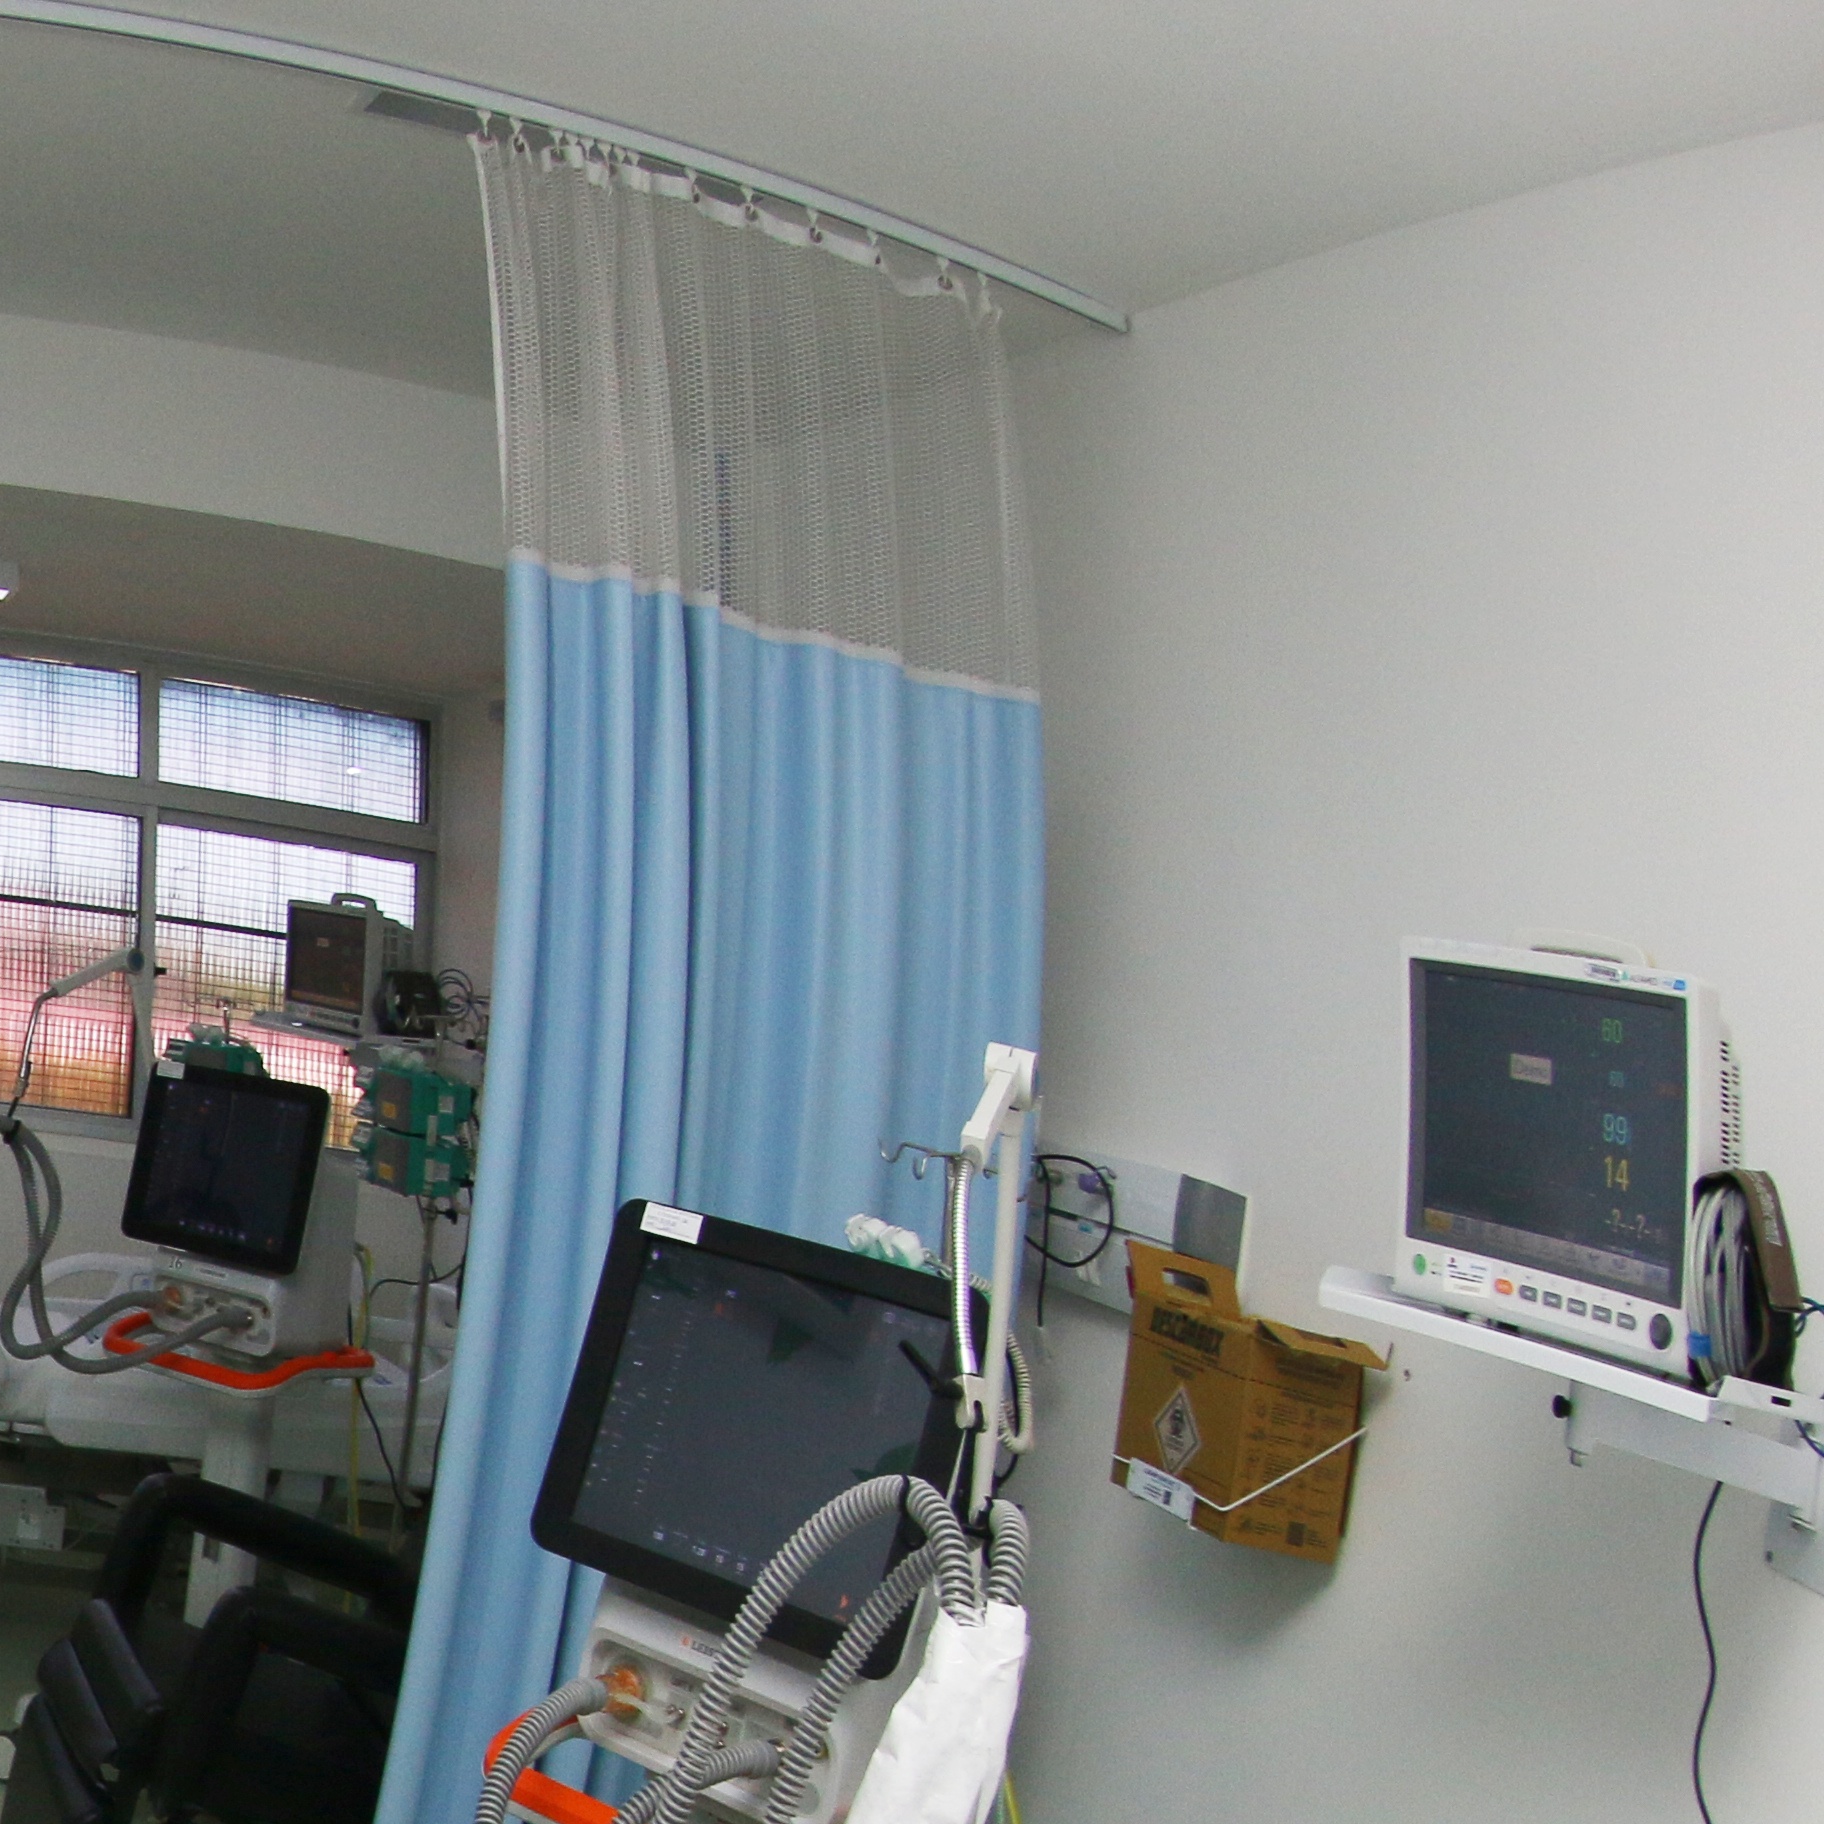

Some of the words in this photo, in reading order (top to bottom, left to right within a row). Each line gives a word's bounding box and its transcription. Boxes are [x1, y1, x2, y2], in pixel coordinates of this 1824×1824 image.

[1601, 1017, 1623, 1044] 60
[1602, 1113, 1630, 1146] 99
[1603, 1155, 1630, 1192] 14
